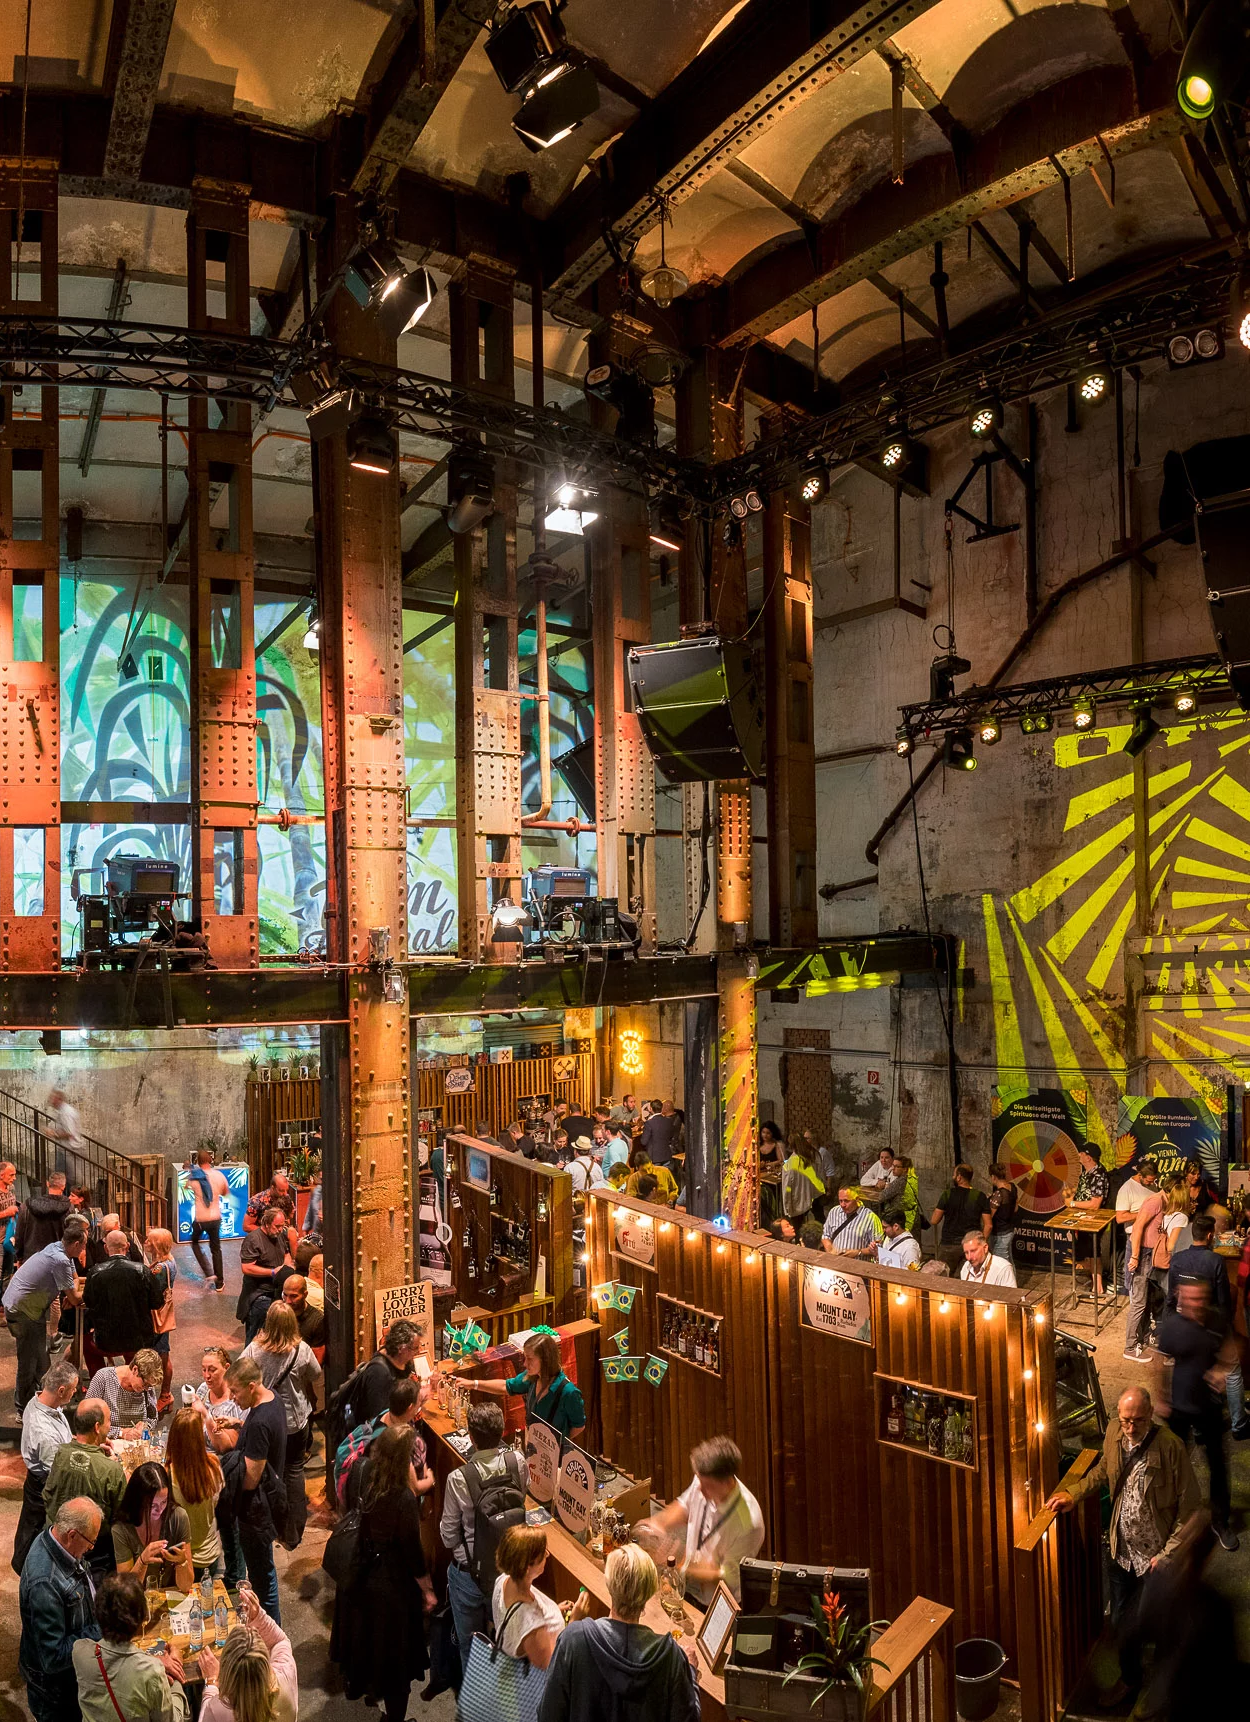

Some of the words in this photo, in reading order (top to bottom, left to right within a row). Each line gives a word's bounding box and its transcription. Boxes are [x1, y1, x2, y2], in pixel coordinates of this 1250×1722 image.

[1157, 1149, 1178, 1157] VIENNA
[382, 1285, 425, 1300] JERRY
[383, 1294, 426, 1312] LOVES
[816, 1301, 841, 1317] MOUNT
[842, 1308, 857, 1321] GAY
[383, 1305, 426, 1319] GINGER
[822, 1314, 837, 1326] 1703
[565, 1459, 589, 1487] BRUGAL
[559, 1486, 576, 1508] MOUNT
[576, 1500, 587, 1516] GAY
